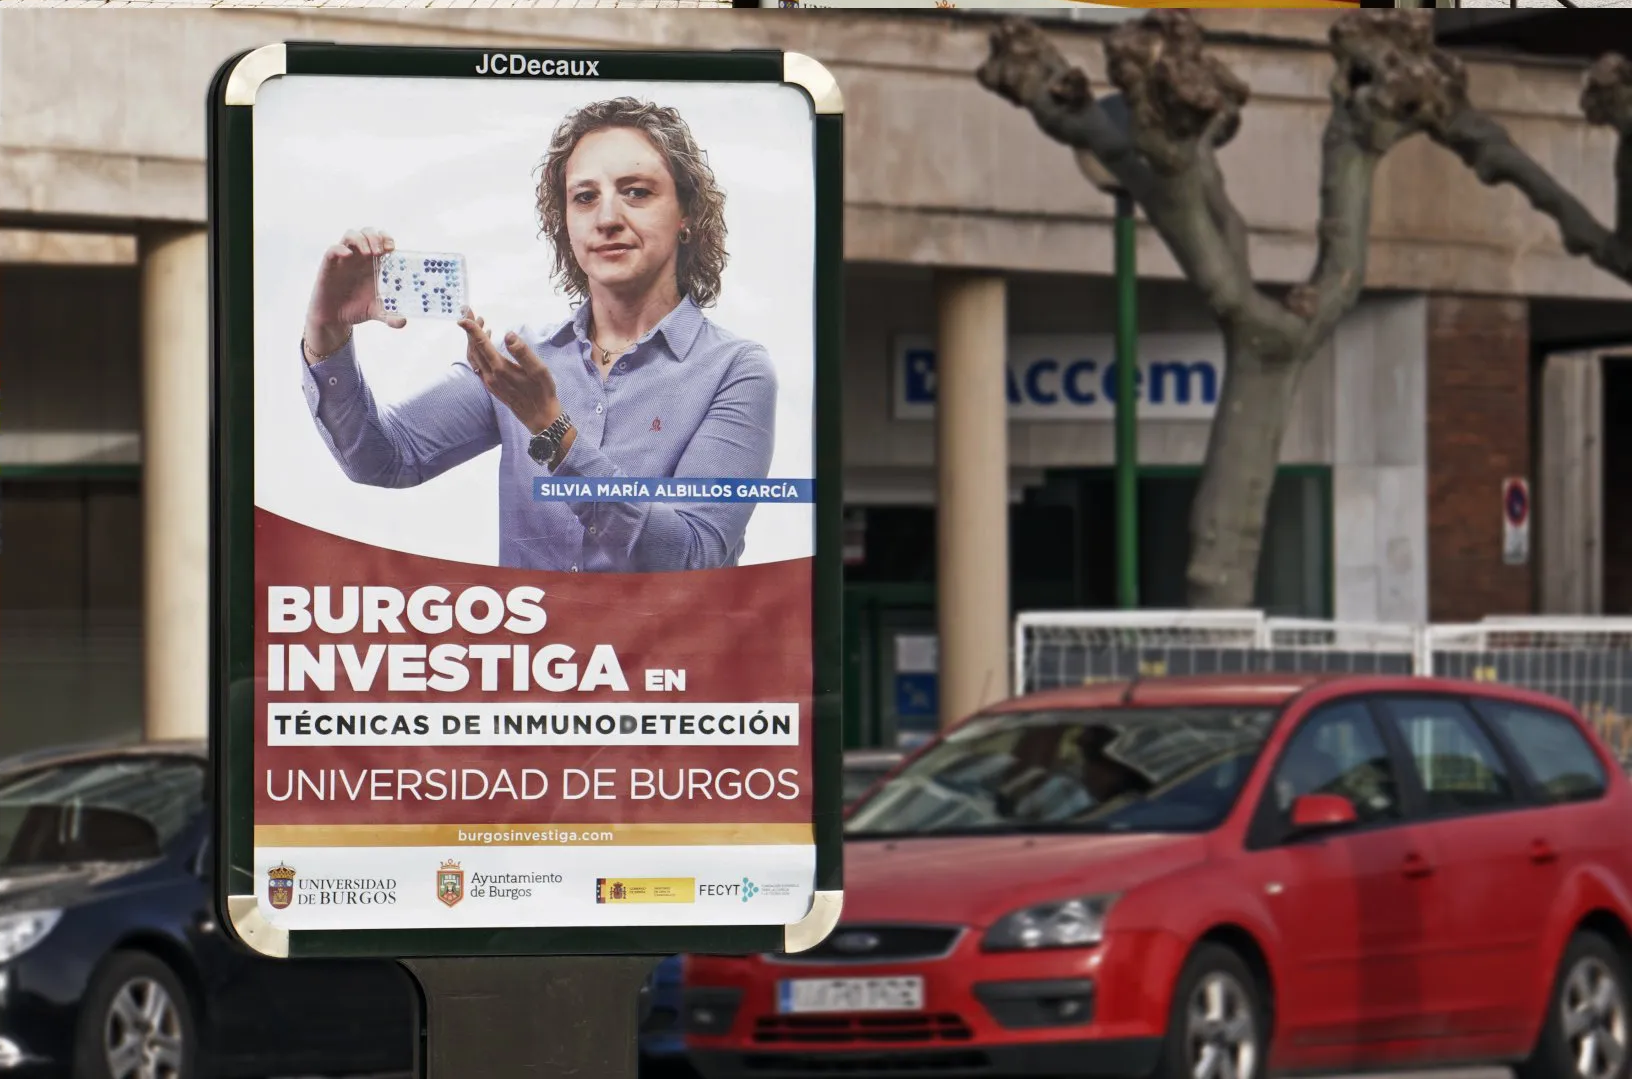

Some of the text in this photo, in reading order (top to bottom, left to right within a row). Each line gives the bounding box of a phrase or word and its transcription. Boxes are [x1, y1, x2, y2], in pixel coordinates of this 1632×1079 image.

[475, 53, 600, 76] JCDecaux
[540, 481, 799, 498] SILVIA MARÍA ALBILLOS GARCÍA
[268, 586, 546, 634] BURGOS
[268, 644, 686, 692] INVESTIGA EN
[275, 709, 790, 735] TÉCNICAS DE INMUNODETECCIÓN
[267, 768, 799, 801] UNIVERSIDAD DE BURGOS
[458, 829, 614, 844] burgosinvestiga.com
[299, 878, 397, 890] UNIVERSIDAD
[470, 872, 563, 887] Ayuntamiento
[298, 891, 397, 905] DE BURGOS
[470, 884, 532, 901] de Burgos
[699, 884, 741, 896] FECYT
